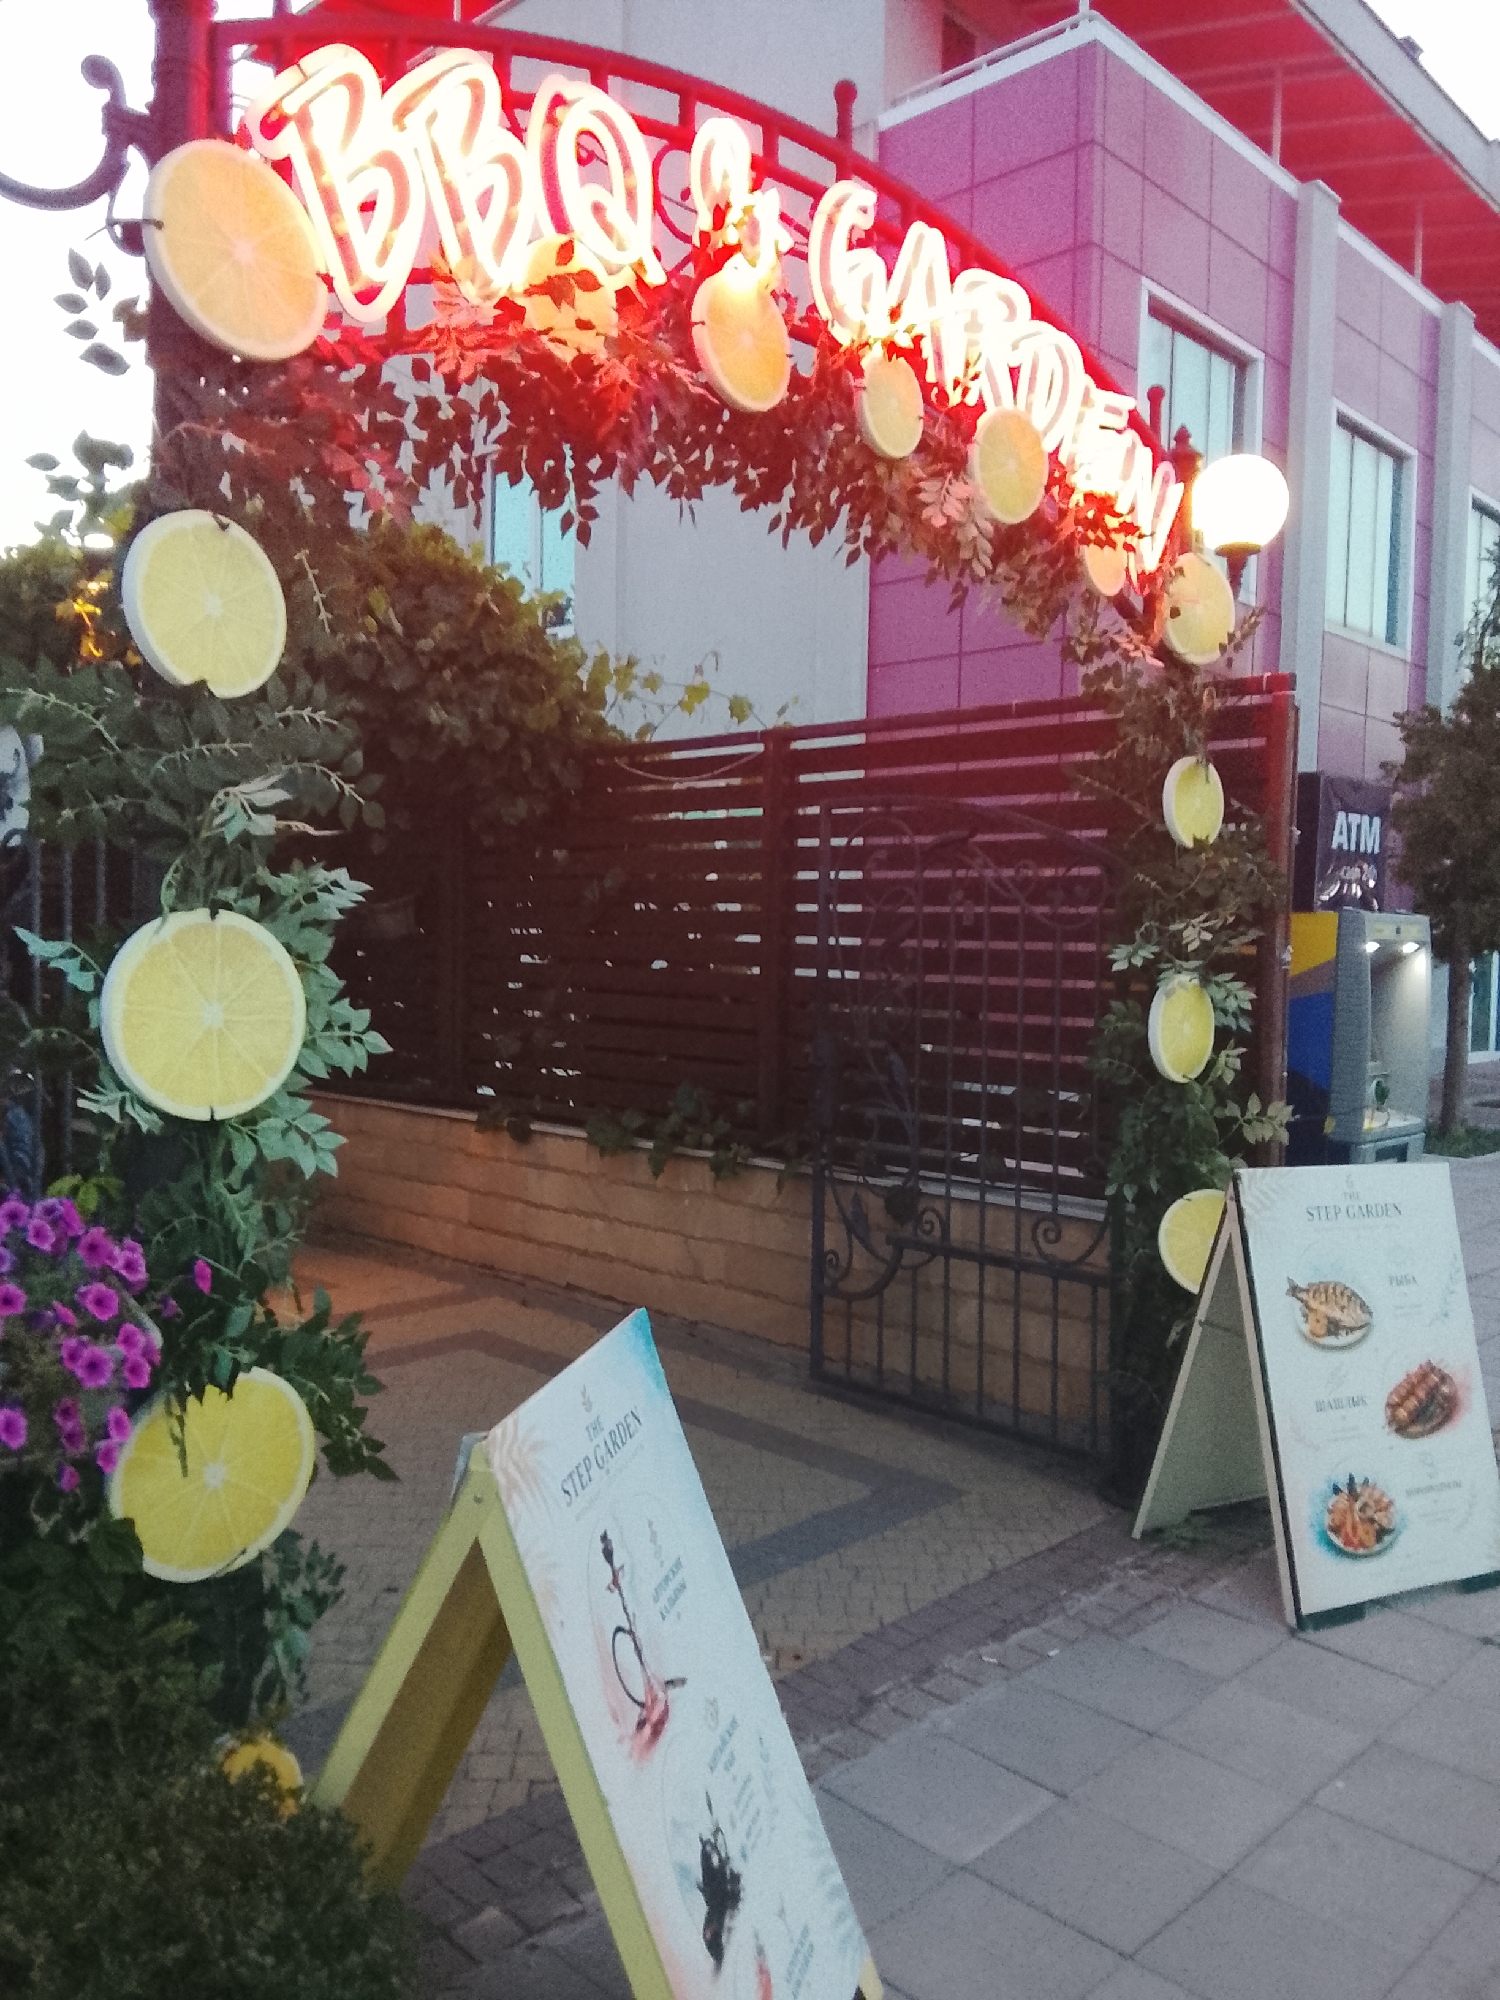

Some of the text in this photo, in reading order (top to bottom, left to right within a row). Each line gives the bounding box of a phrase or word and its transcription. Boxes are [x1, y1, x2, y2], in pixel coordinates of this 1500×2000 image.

[246, 42, 668, 322] BBQ
[808, 179, 1185, 594] GARDEN
[1330, 810, 1382, 855] ATM
[1306, 1202, 1403, 1222] STEP GARDEN
[585, 1414, 605, 1443] THE
[560, 1455, 594, 1508] STEP
[594, 1404, 643, 1471] GARDEN
